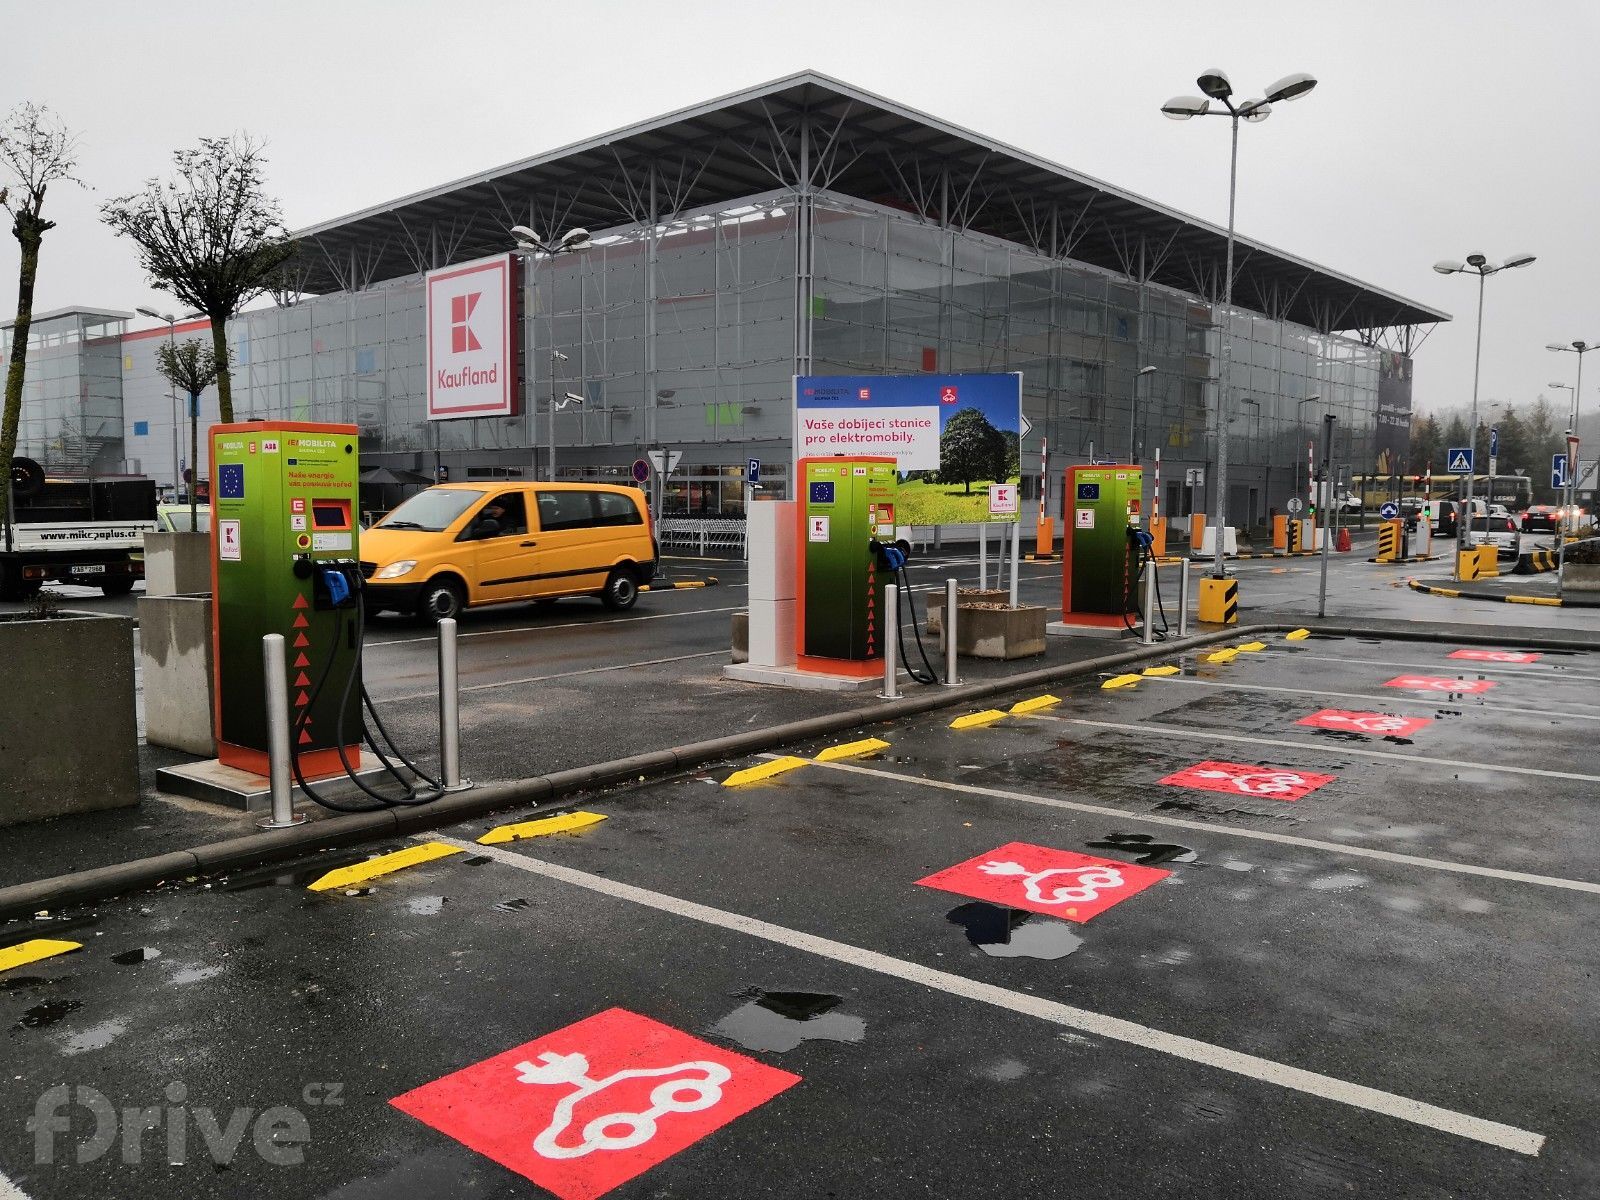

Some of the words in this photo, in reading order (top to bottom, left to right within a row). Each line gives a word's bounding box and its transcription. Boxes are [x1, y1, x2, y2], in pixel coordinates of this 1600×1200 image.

[438, 363, 497, 388] Kaufland
[805, 419, 834, 430] Vaše
[838, 418, 885, 431] dobíjecí
[889, 418, 931, 428] stanice
[805, 434, 825, 445] pro
[830, 432, 915, 443] elektromobily.
[750, 461, 758, 475] P
